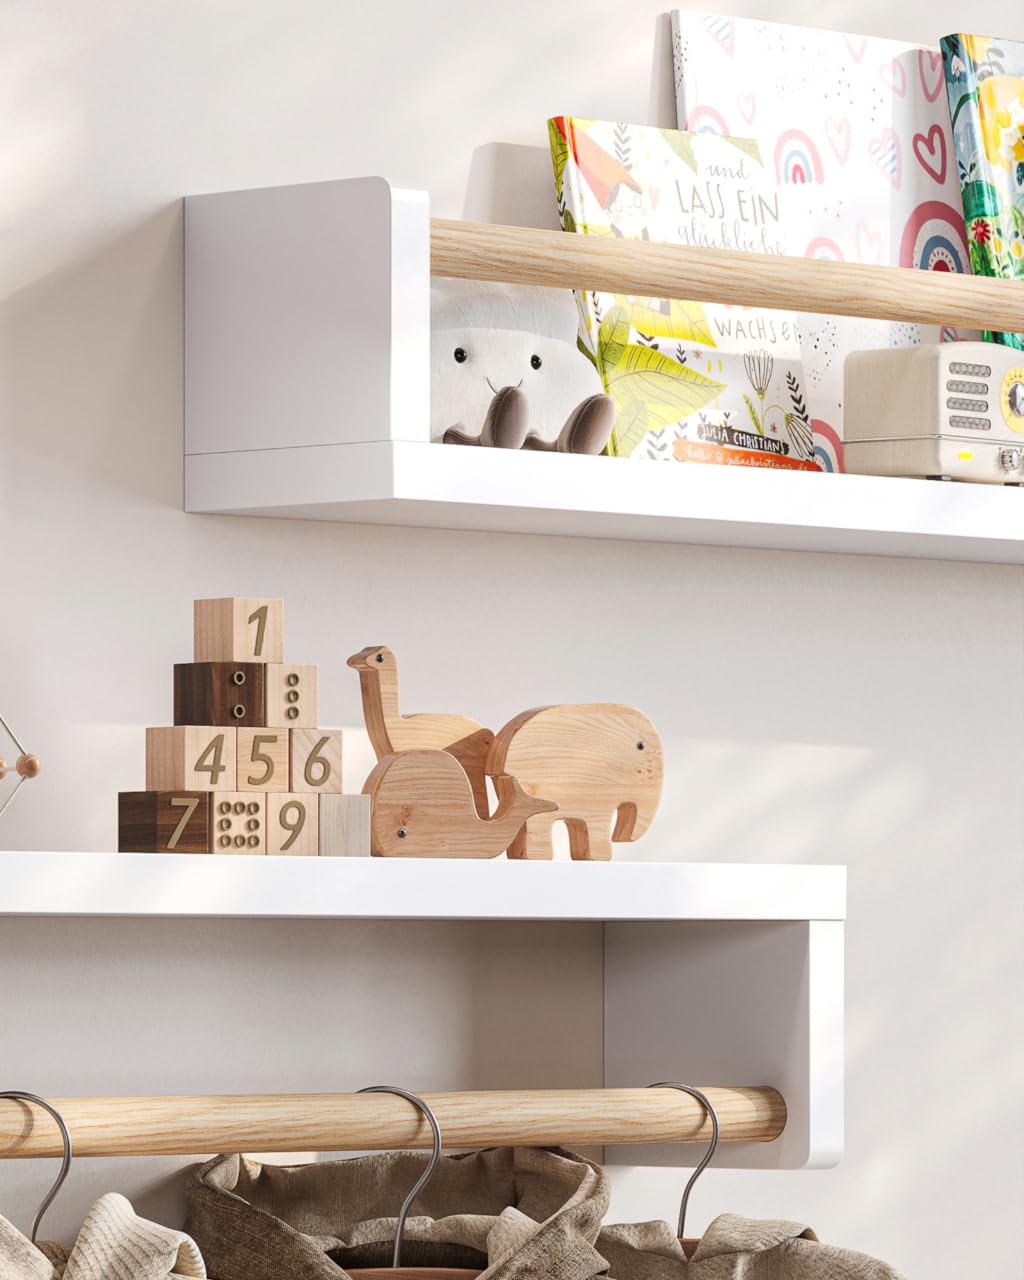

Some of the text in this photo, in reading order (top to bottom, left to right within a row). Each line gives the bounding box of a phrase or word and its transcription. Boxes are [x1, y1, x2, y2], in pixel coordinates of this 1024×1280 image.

[704, 158, 752, 180] und
[675, 179, 726, 220] LASS
[248, 605, 269, 656] 1
[194, 734, 331, 787] 4 5 6
[166, 797, 306, 850] 7 9
